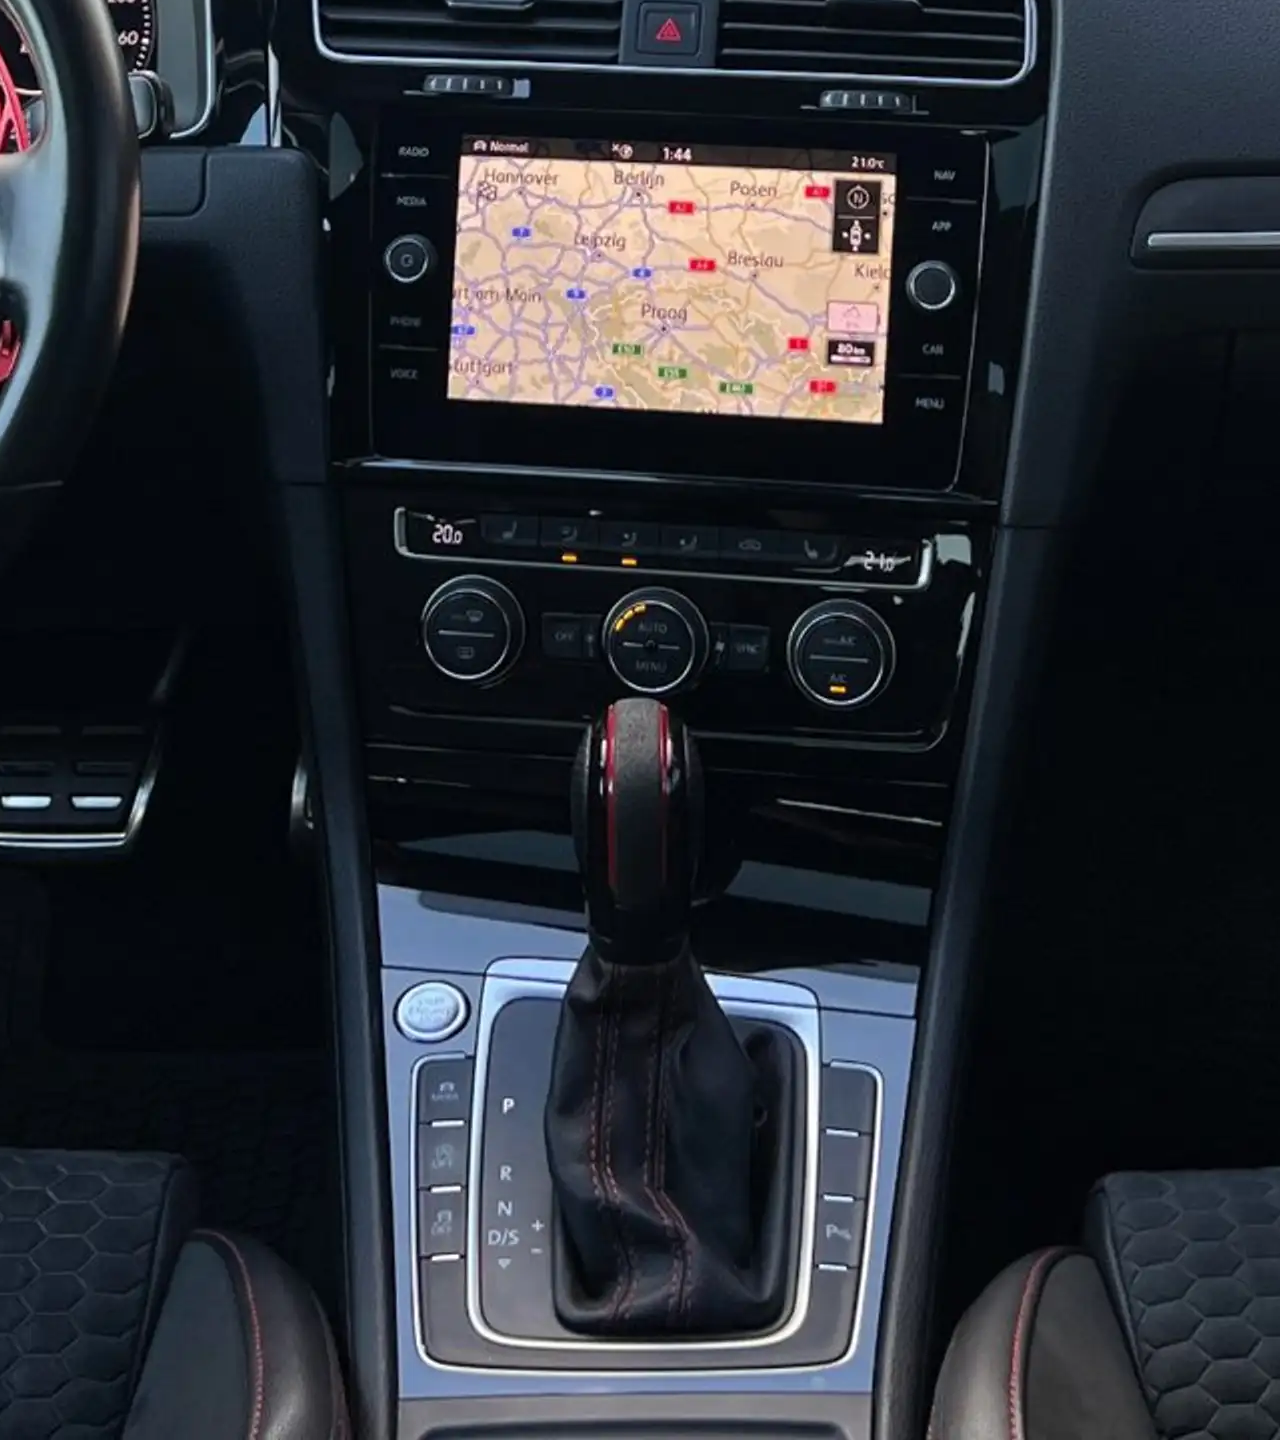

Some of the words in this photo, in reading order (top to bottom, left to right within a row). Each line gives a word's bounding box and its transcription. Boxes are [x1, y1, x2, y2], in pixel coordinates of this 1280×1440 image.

[397, 145, 431, 159] RADIO
[490, 140, 529, 153] Normal
[662, 146, 693, 162] 1:44
[483, 167, 559, 185] Hannover
[933, 169, 957, 182] NAV
[729, 180, 778, 198] Posen
[396, 194, 428, 207] MEDIA
[931, 220, 953, 233] APP
[574, 233, 627, 252] Leipzig
[727, 251, 784, 268] Breslau
[505, 287, 542, 303] Main
[640, 303, 688, 322] Praag
[389, 366, 419, 381] VOICE
[915, 396, 945, 411] MENU
[637, 622, 668, 635] AUTO
[635, 659, 668, 674] MENU
[502, 1097, 516, 1115] P
[499, 1165, 513, 1182] R
[497, 1200, 513, 1218] N
[487, 1228, 520, 1246] D/S
